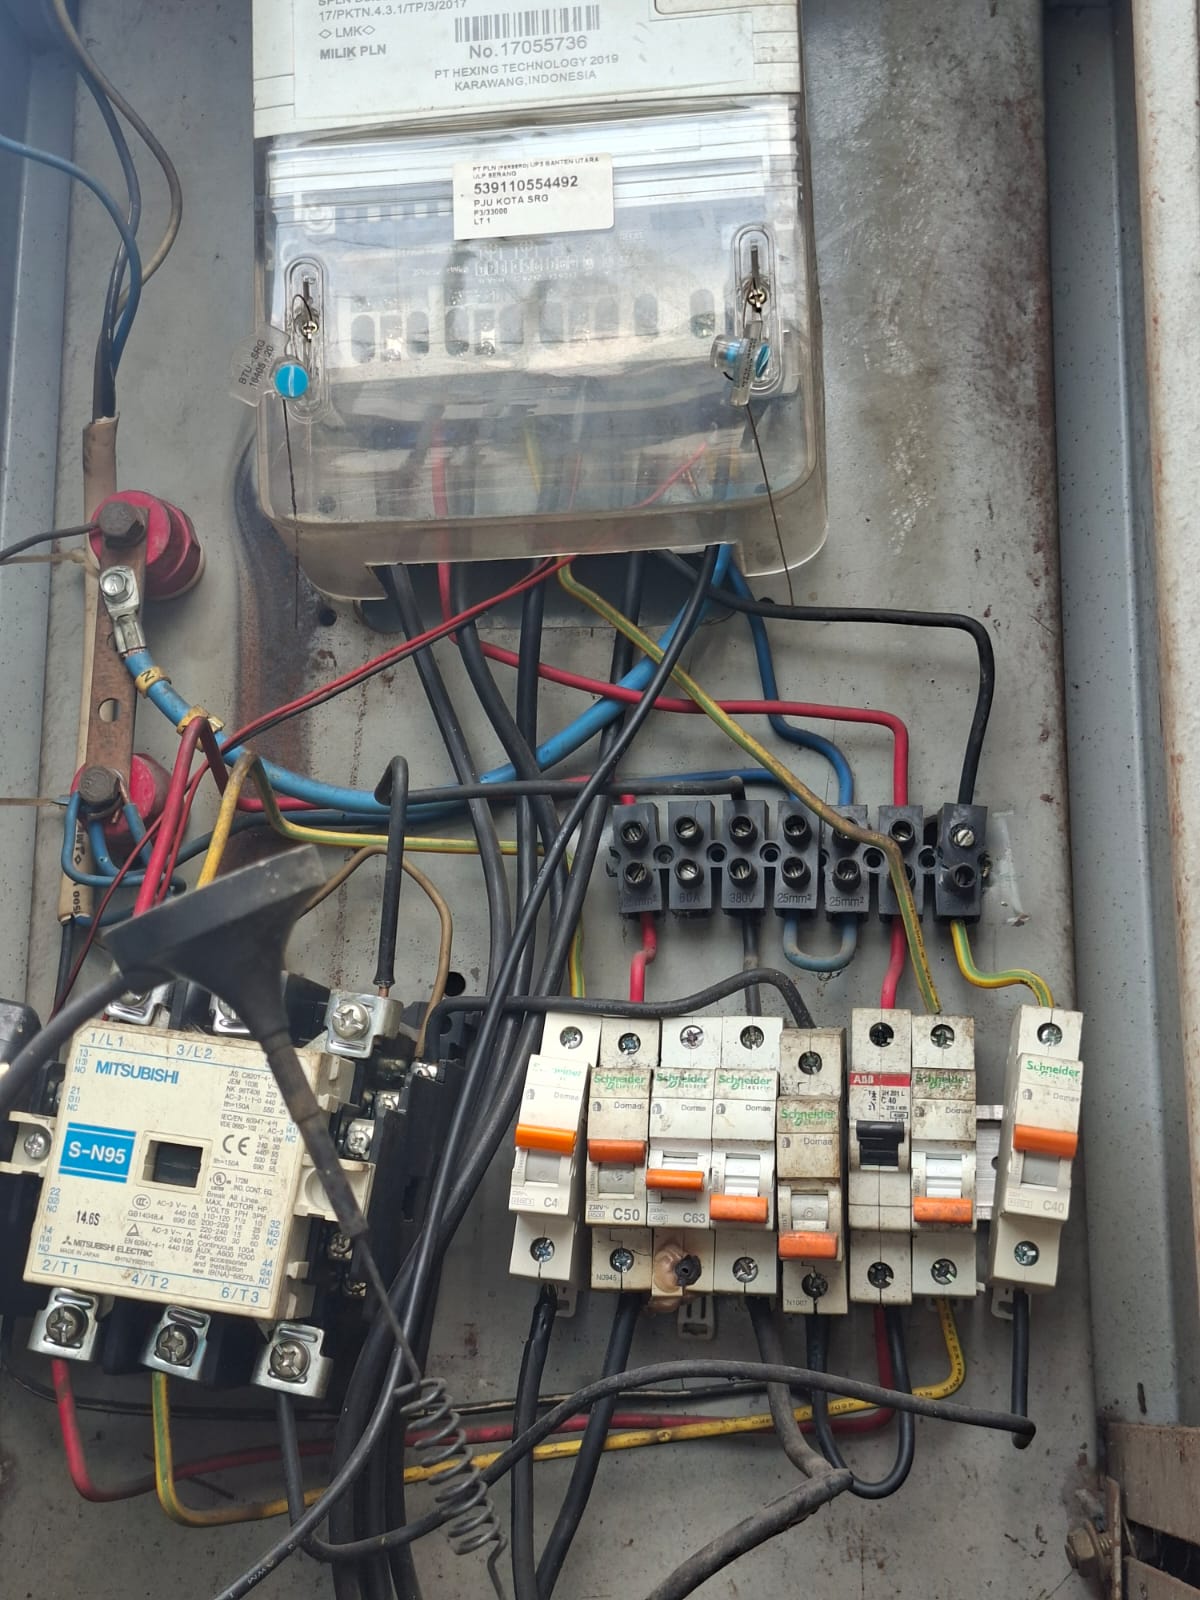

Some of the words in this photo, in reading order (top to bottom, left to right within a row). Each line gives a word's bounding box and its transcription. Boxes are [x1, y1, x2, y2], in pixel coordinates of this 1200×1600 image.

[335, 25, 362, 38] LMK
[320, 46, 356, 60] MILIK
[360, 44, 386, 56] PLN
[469, 35, 588, 59] No.17055736
[434, 69, 450, 79] PT
[452, 65, 499, 78] HEXING
[501, 56, 587, 73] TECHNOLOGY
[589, 54, 619, 66] 2019
[454, 70, 597, 91] KARAWANG,INDONESIA
[474, 175, 578, 195] 539110554492
[474, 199, 493, 207] PJU
[496, 195, 524, 206] KOTA
[527, 194, 549, 204] SRG
[95, 1060, 180, 1085] MITSUBISHI
[1027, 1060, 1080, 1077] Schneider
[594, 1074, 645, 1090] Schneider
[656, 1072, 709, 1088] Schneider
[718, 1074, 772, 1090] Schneider
[854, 1075, 874, 1084] ABB
[745, 1104, 771, 1112] Domae
[781, 1108, 836, 1126] Schneider
[222, 1134, 251, 1156] CE
[804, 1137, 833, 1146] Domae
[68, 1141, 126, 1165] S-N95
[206, 1206, 230, 1215] VOLTS
[226, 1201, 254, 1211] MOTOR
[613, 1207, 640, 1221] C50
[1043, 1200, 1065, 1213] C40
[76, 1209, 101, 1227] 14.6S
[683, 1212, 706, 1223] C63
[73, 1239, 116, 1252] MITSUBISHI
[117, 1245, 153, 1258] ELECTRIC
[197, 1240, 234, 1252] Continuous
[262, 1259, 273, 1268] 44
